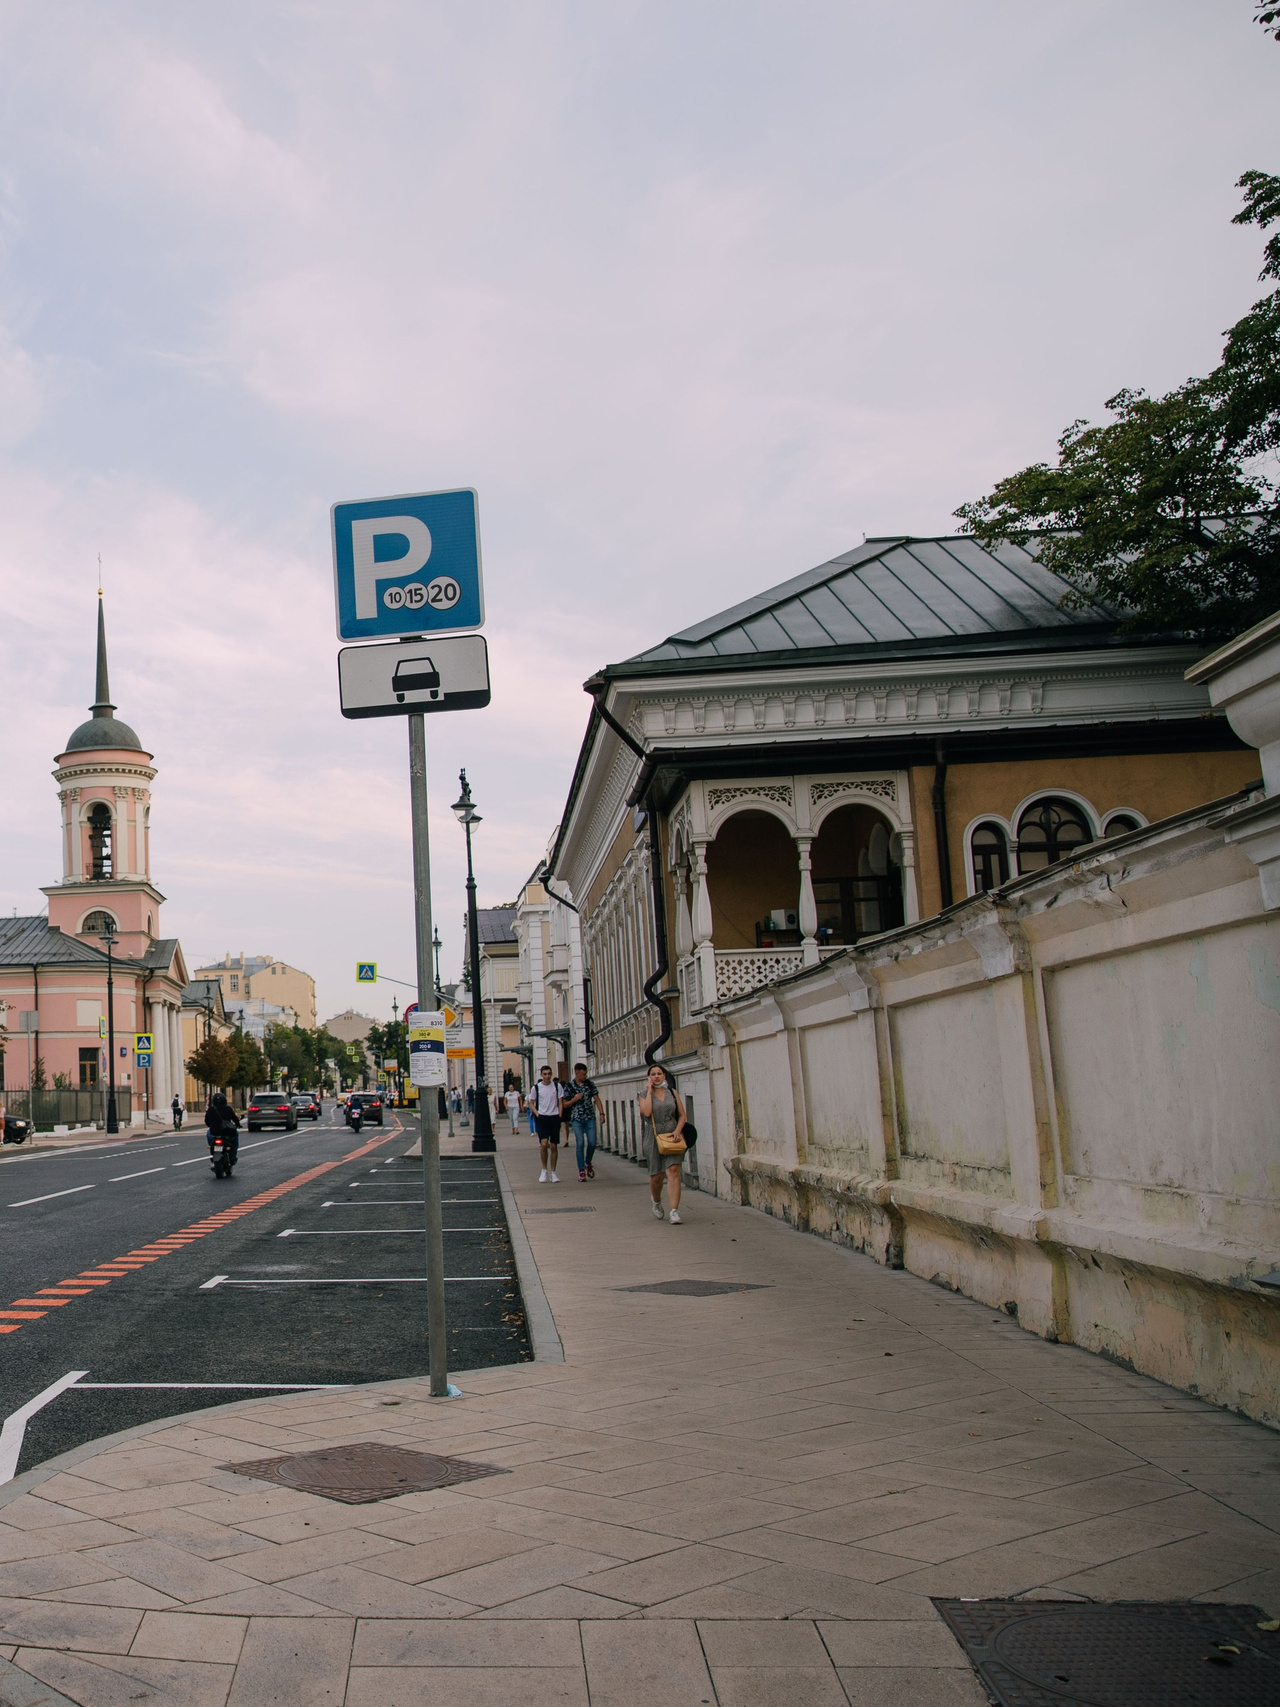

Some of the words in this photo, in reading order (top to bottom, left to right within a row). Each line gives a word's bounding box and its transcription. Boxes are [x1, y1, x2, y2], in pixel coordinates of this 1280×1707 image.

[352, 515, 432, 620] P
[388, 592, 402, 604] 10
[407, 588, 424, 604] 15
[430, 583, 457, 603] 20
